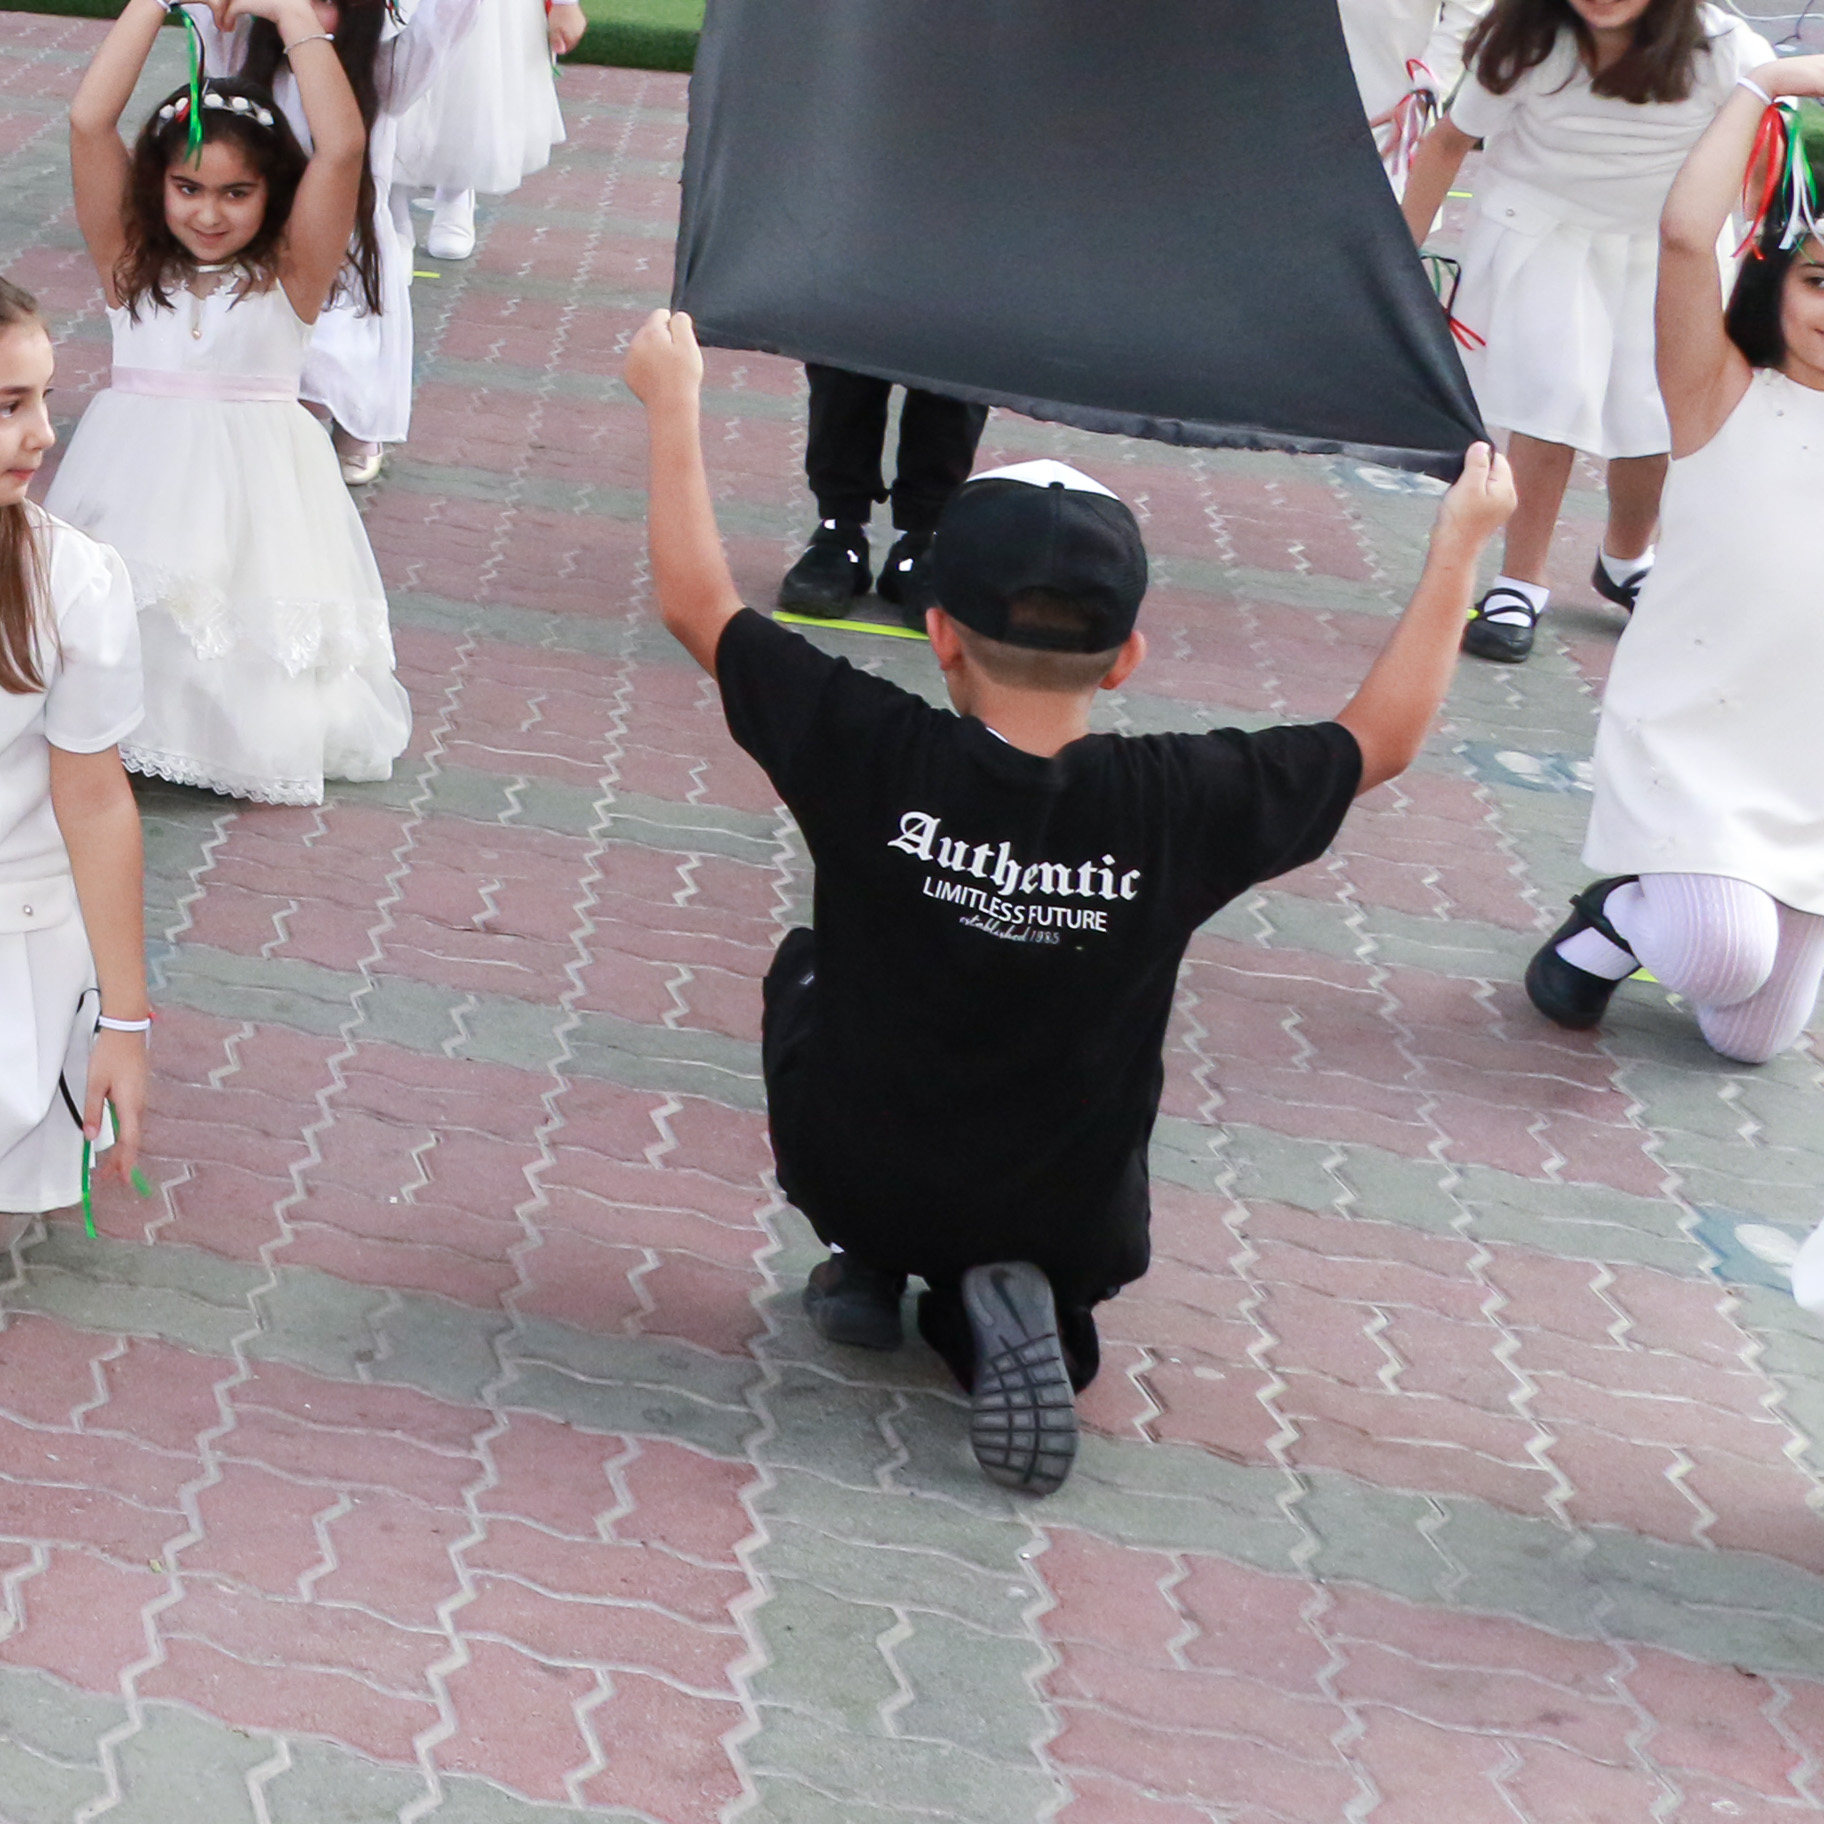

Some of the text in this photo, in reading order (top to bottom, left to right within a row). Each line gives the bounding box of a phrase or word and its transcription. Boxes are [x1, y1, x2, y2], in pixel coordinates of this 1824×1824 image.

[887, 810, 1141, 901] Authentic
[922, 876, 1108, 933] LIMITLESS FUTURE
